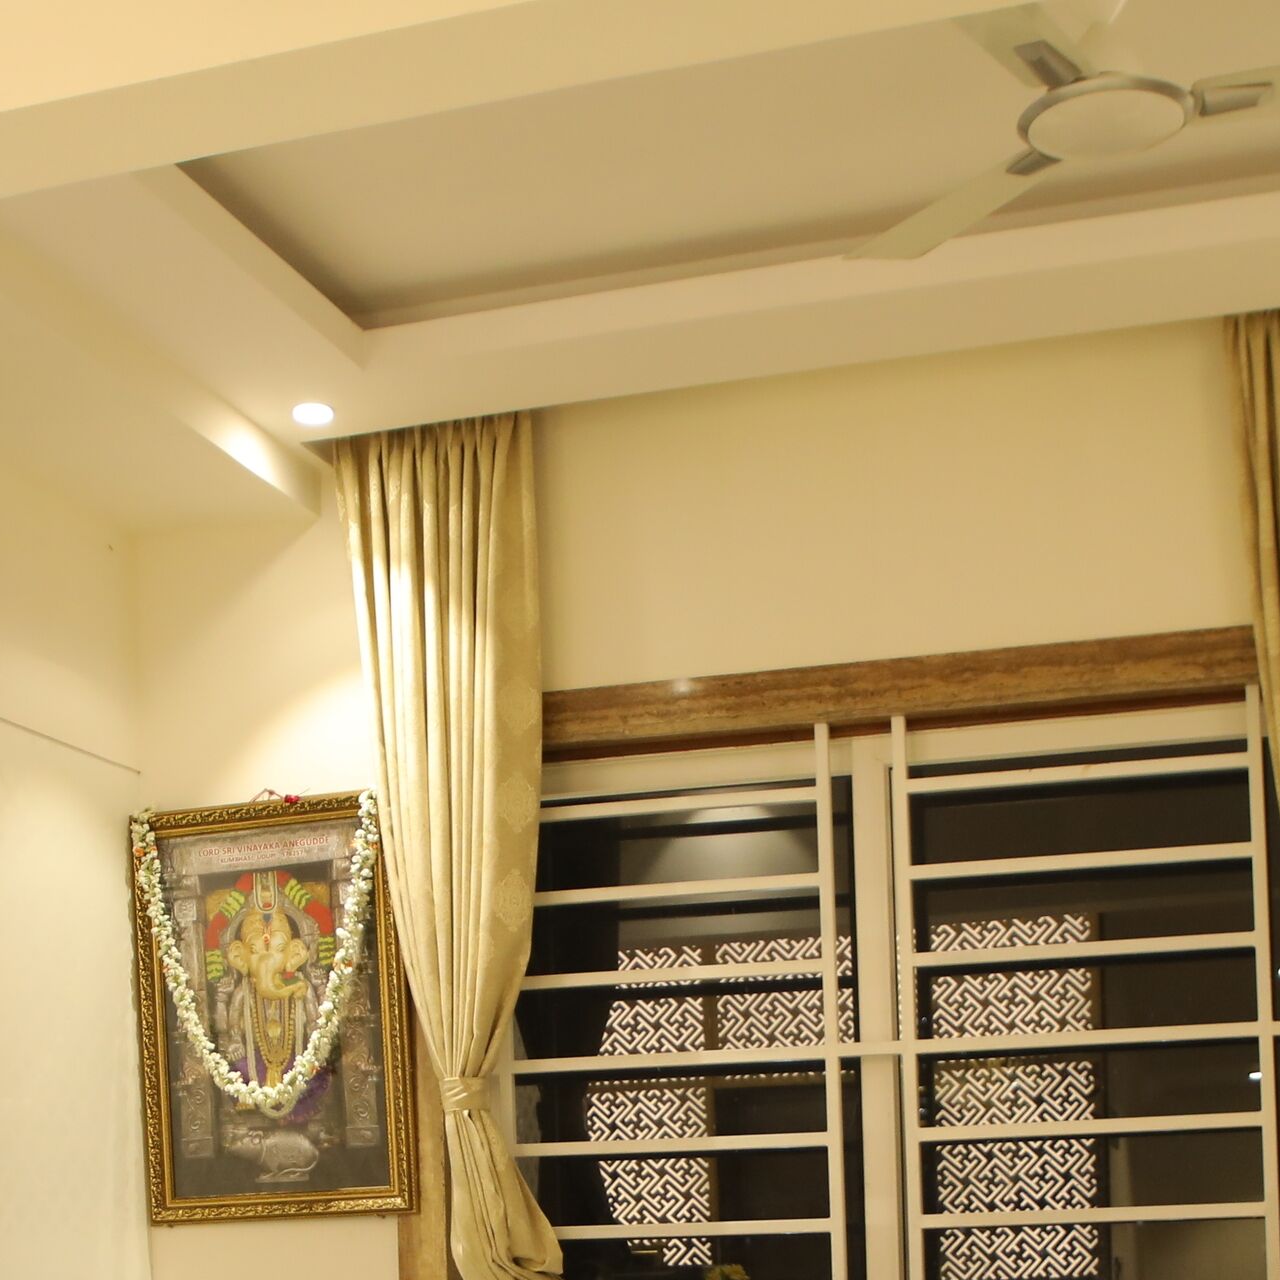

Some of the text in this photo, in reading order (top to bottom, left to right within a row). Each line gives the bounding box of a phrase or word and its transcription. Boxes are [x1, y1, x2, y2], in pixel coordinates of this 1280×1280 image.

[199, 837, 329, 857] LORD SRI VINAYAKA ANEGUDDE
